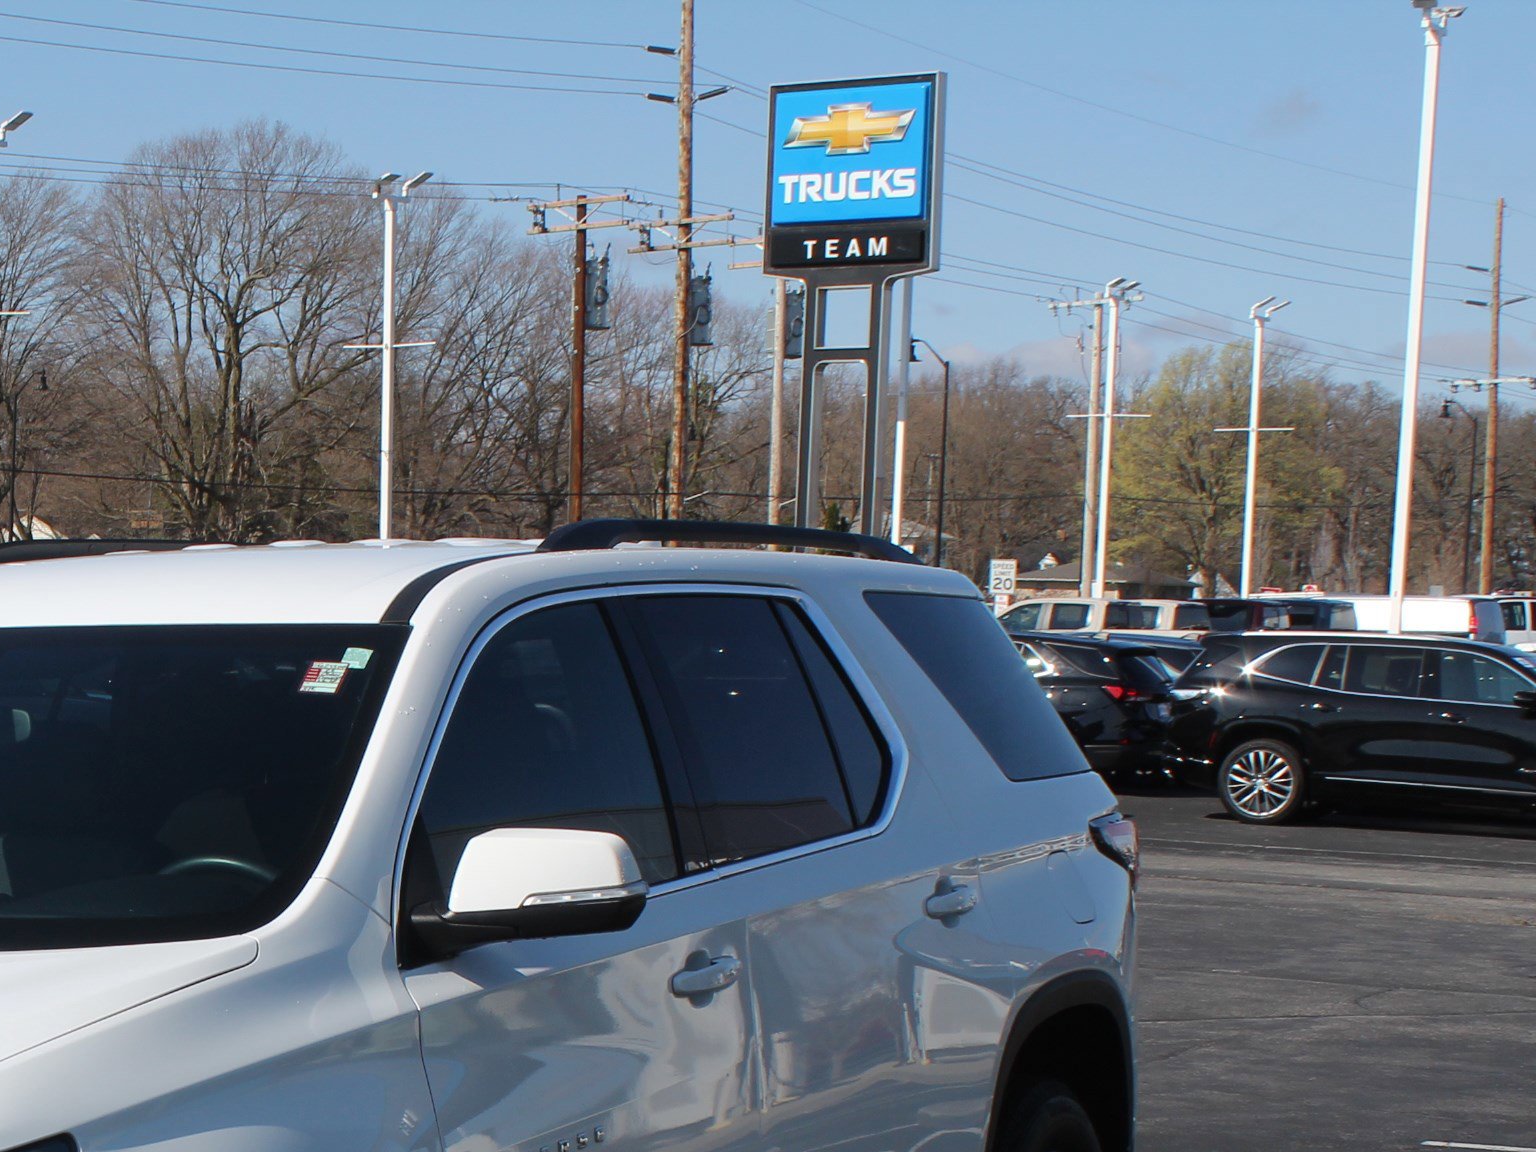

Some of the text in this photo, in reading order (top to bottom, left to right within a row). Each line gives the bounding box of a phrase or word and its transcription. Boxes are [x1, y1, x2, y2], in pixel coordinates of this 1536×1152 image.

[778, 167, 917, 204] TRUCKS
[803, 236, 889, 260] TEAM
[992, 577, 1013, 590] 20
